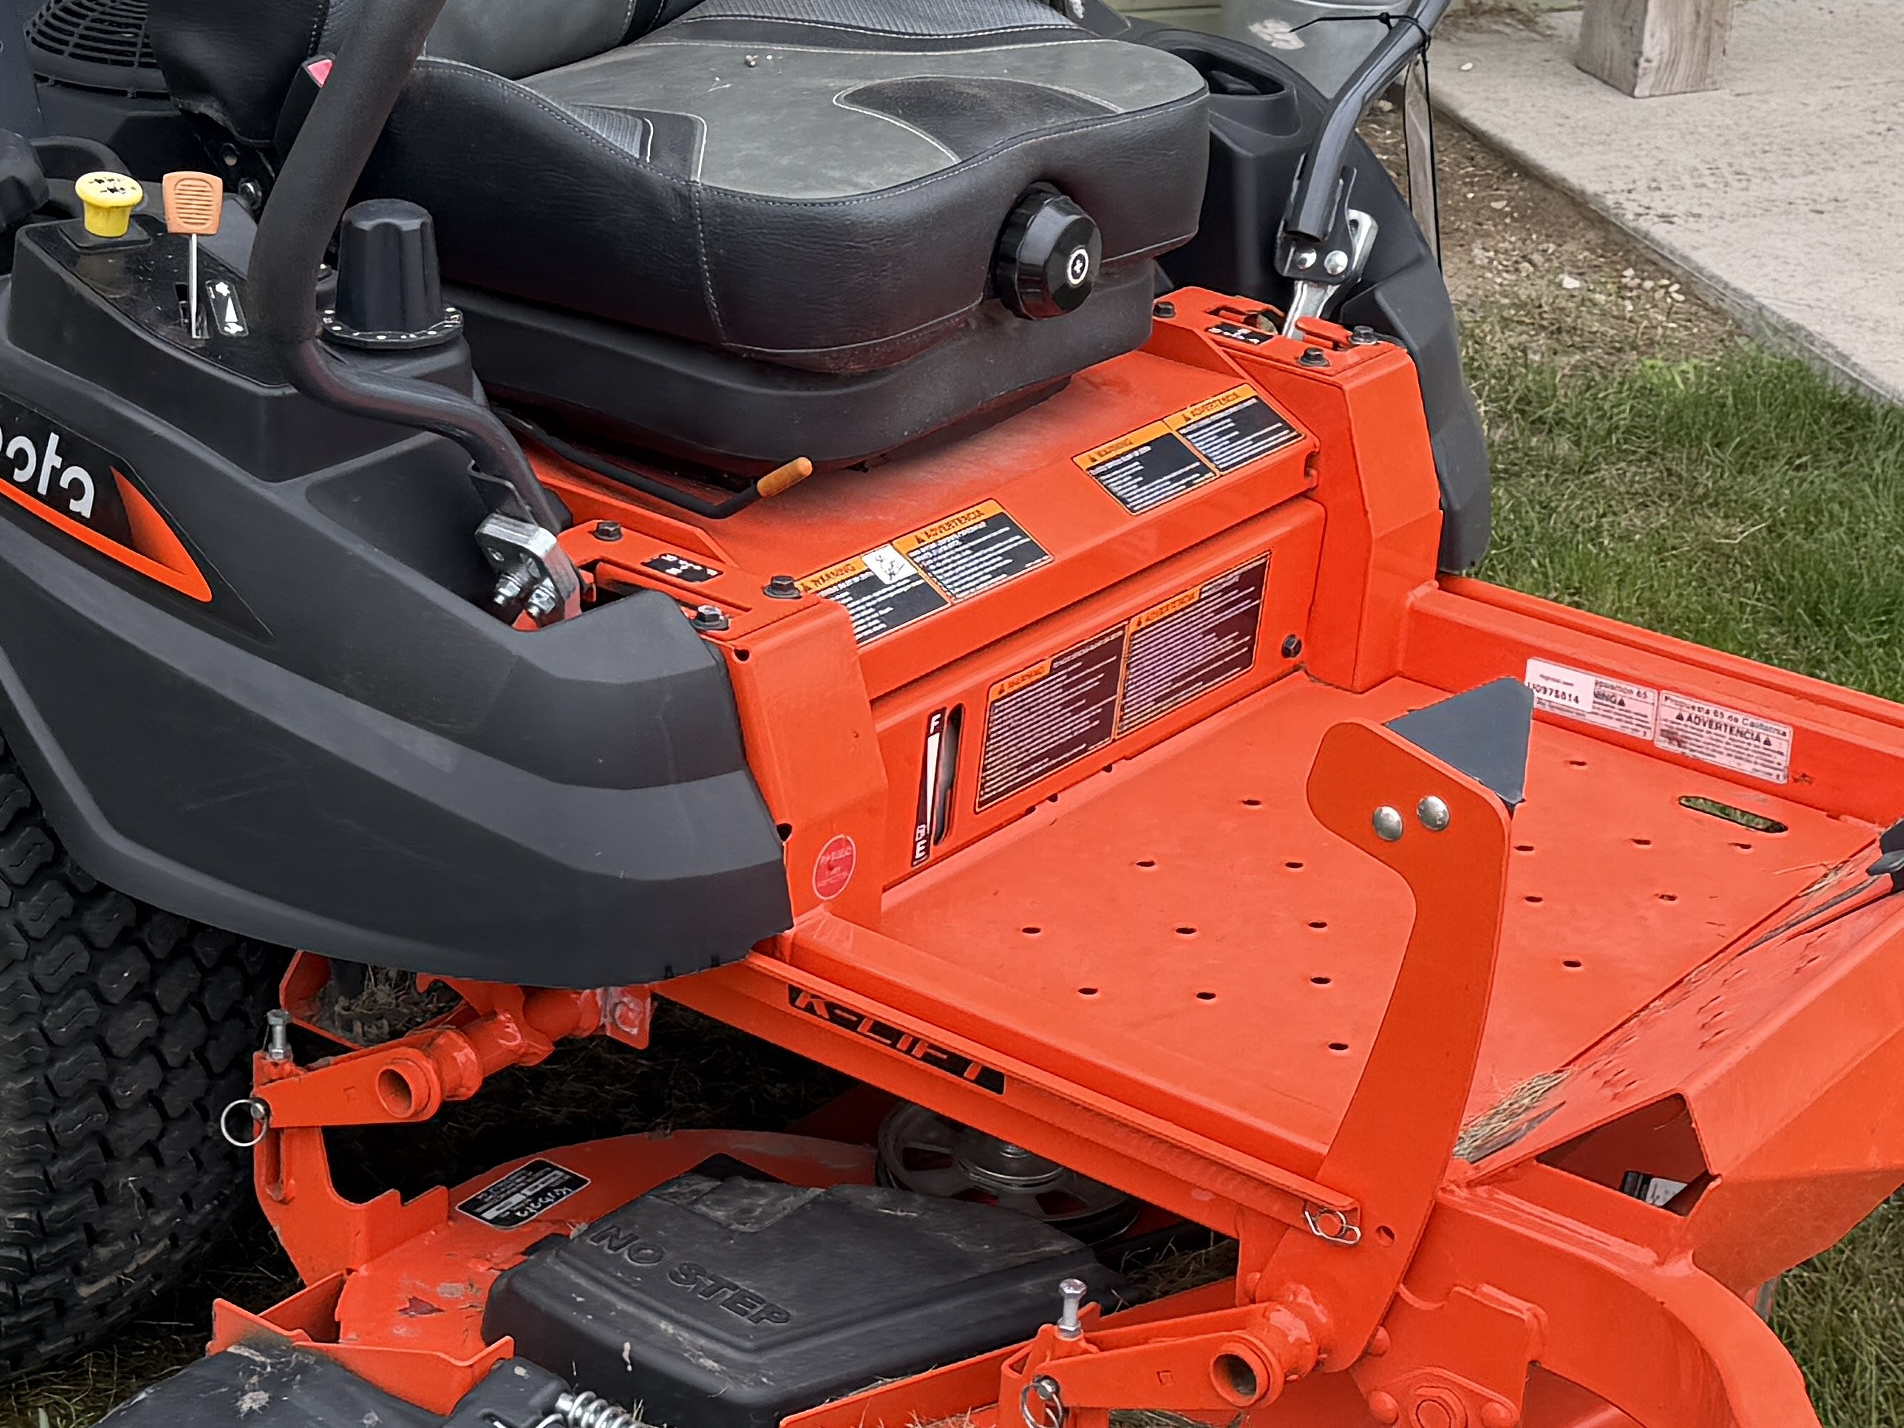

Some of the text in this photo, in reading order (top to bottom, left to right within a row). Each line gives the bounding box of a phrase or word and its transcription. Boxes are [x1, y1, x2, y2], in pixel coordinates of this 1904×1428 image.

[930, 713, 942, 734] F
[1686, 712, 1762, 744] ADVERTENCIA
[915, 840, 927, 859] E
[795, 990, 985, 1081] K-LIFT
[589, 1224, 793, 1326] NO STEP
